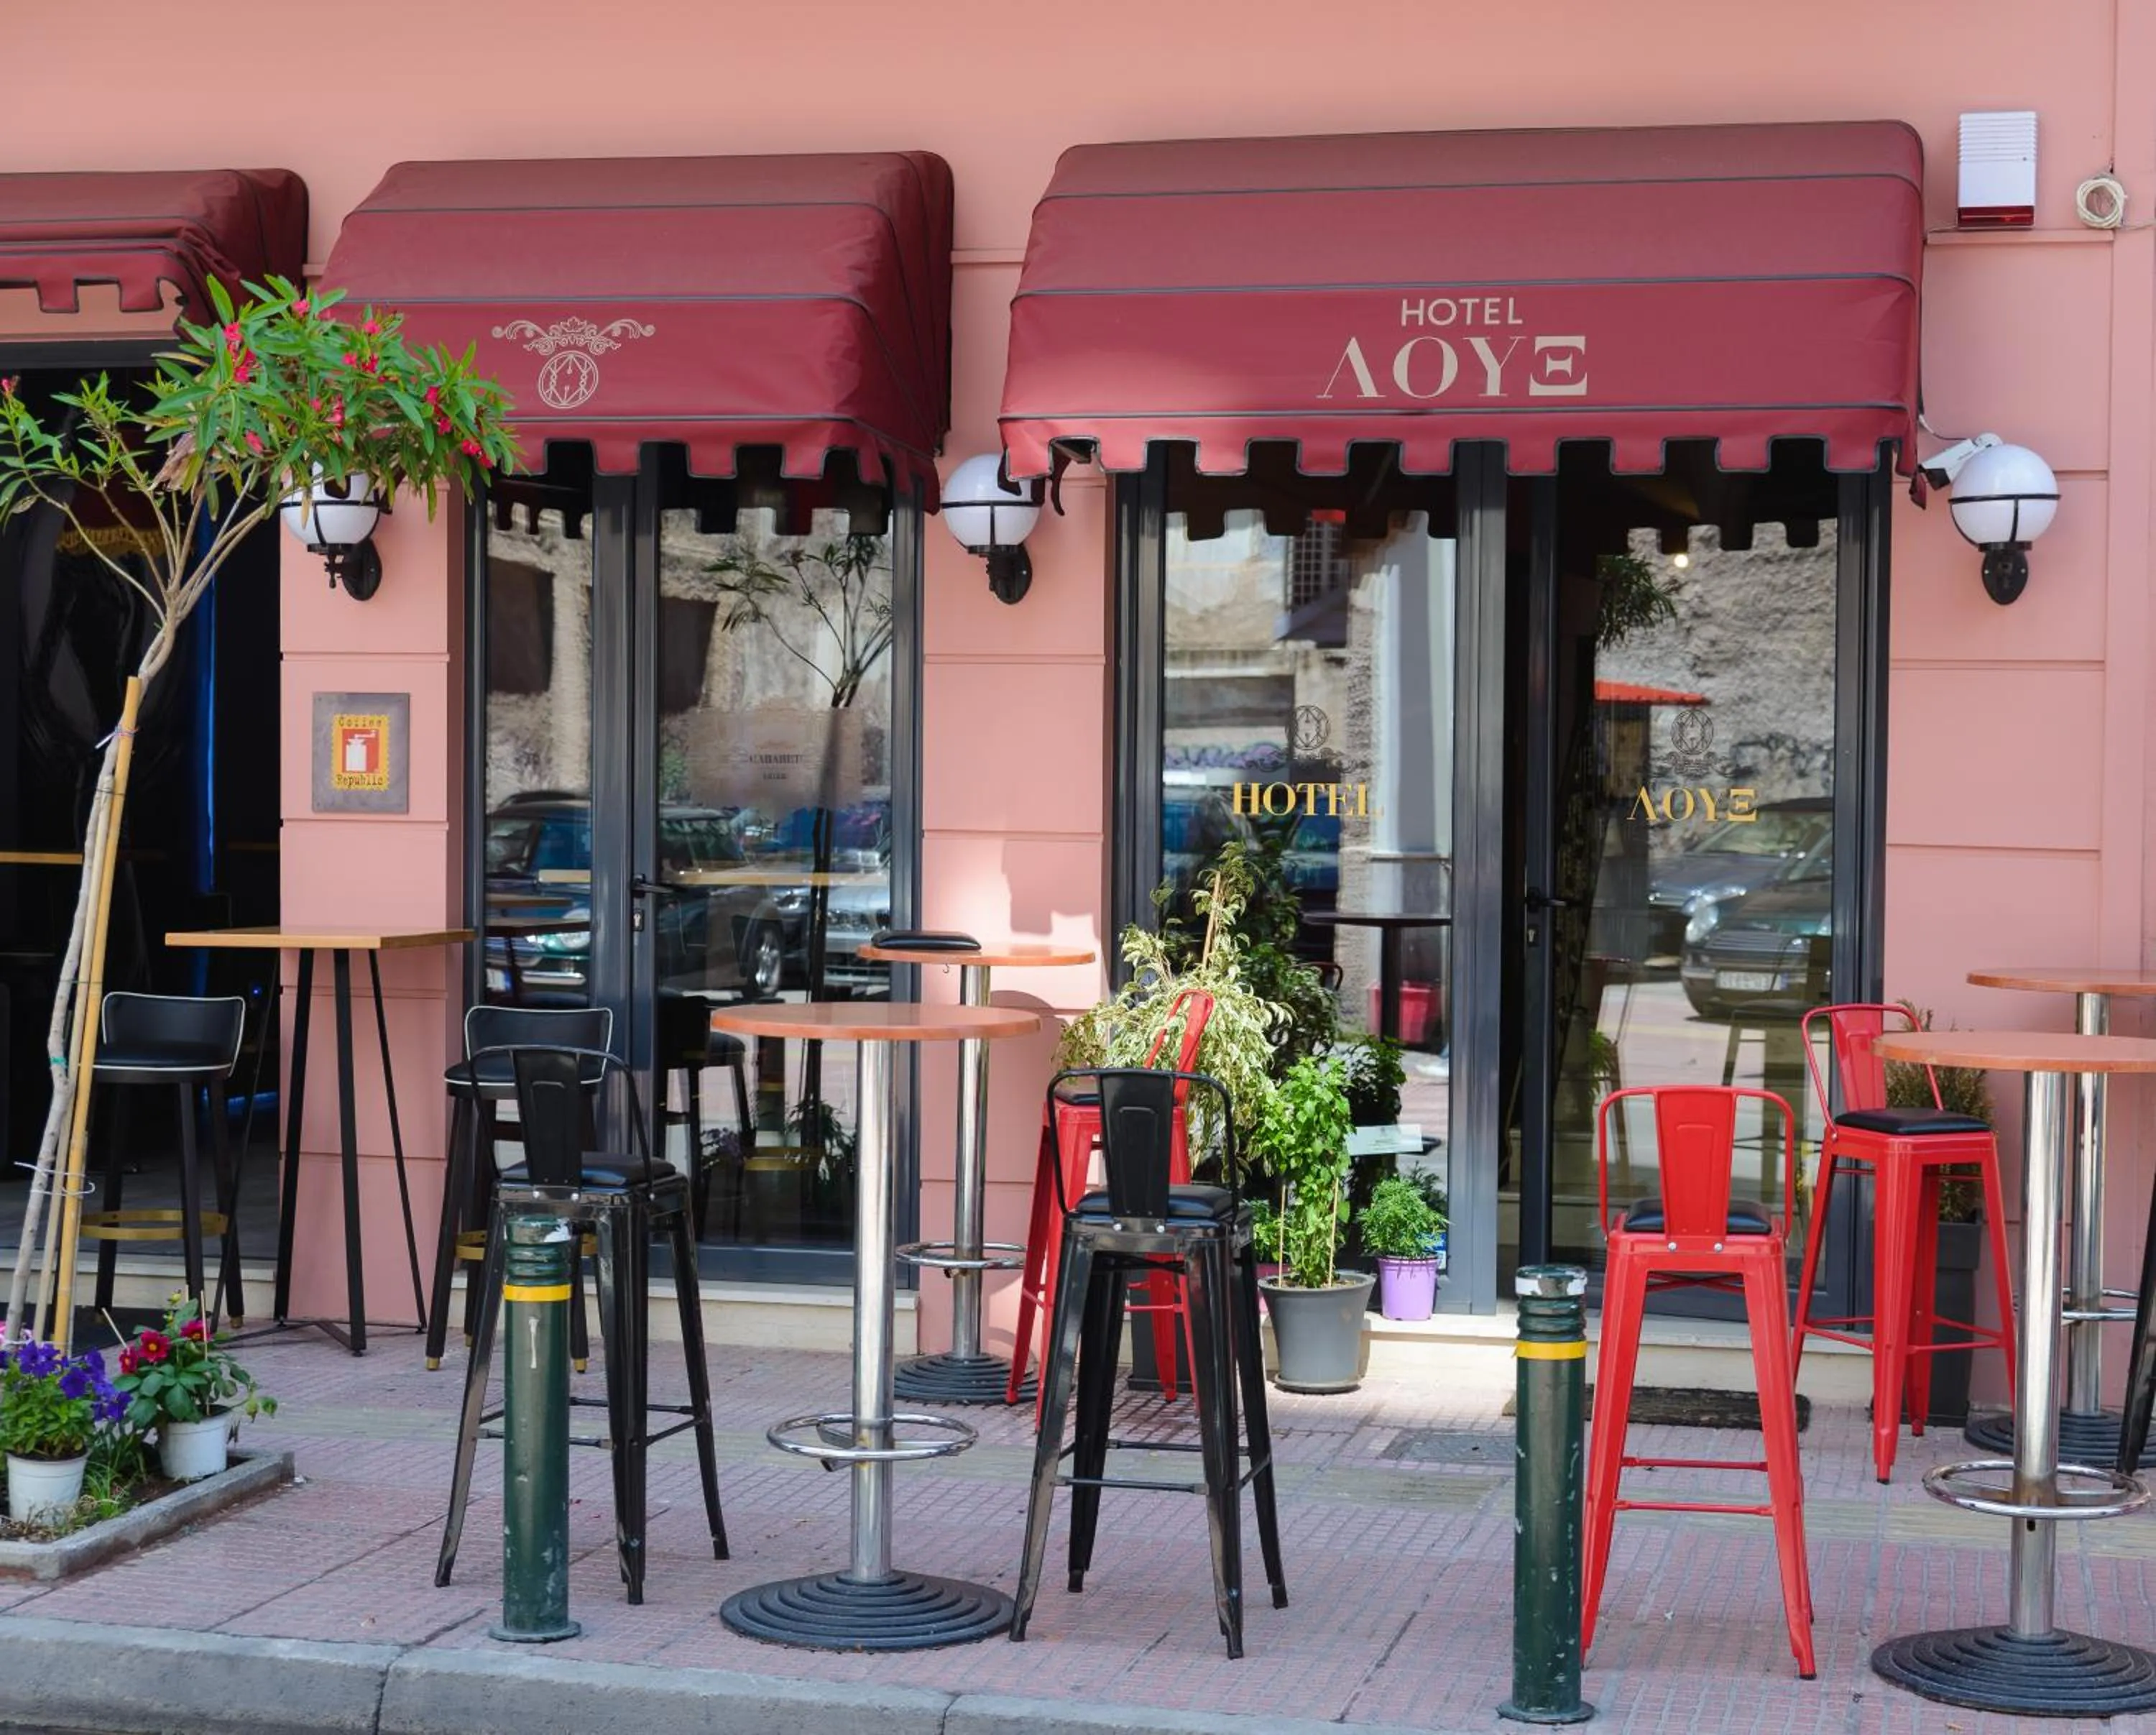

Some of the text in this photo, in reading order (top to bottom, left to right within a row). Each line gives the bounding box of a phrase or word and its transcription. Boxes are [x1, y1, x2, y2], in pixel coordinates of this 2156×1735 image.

[1401, 297, 1524, 326] HOTEL
[1316, 335, 1588, 400] ΛΟΥΞ
[338, 717, 382, 727] Coffee
[336, 774, 384, 788] Republic
[1233, 781, 1384, 817] HOTEL
[1626, 786, 1758, 822] ΛΟΥΞ
